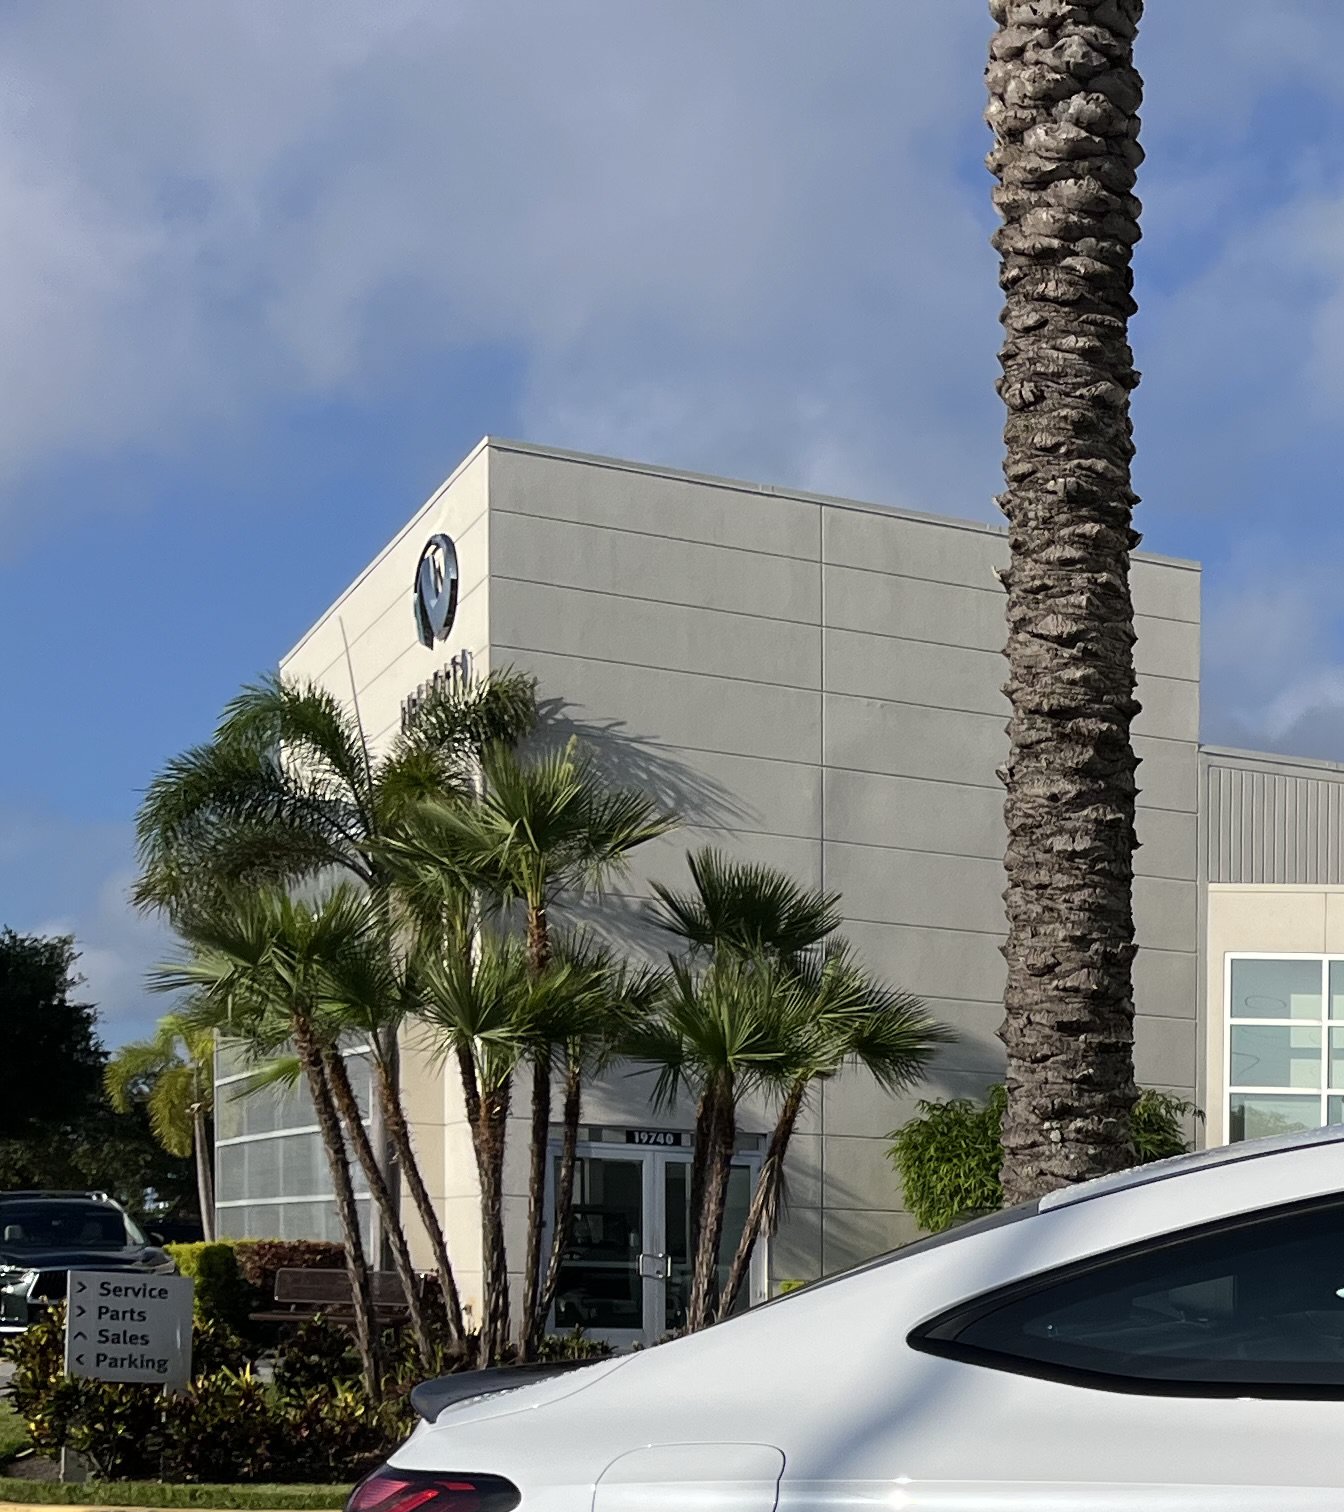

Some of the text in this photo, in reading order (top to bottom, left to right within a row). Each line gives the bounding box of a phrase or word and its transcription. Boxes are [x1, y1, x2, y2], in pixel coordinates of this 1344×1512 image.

[634, 1132, 674, 1145] 19740
[99, 1281, 169, 1299] Service
[98, 1305, 147, 1322] Parts
[97, 1328, 149, 1346] Sales
[95, 1353, 169, 1374] Parking
